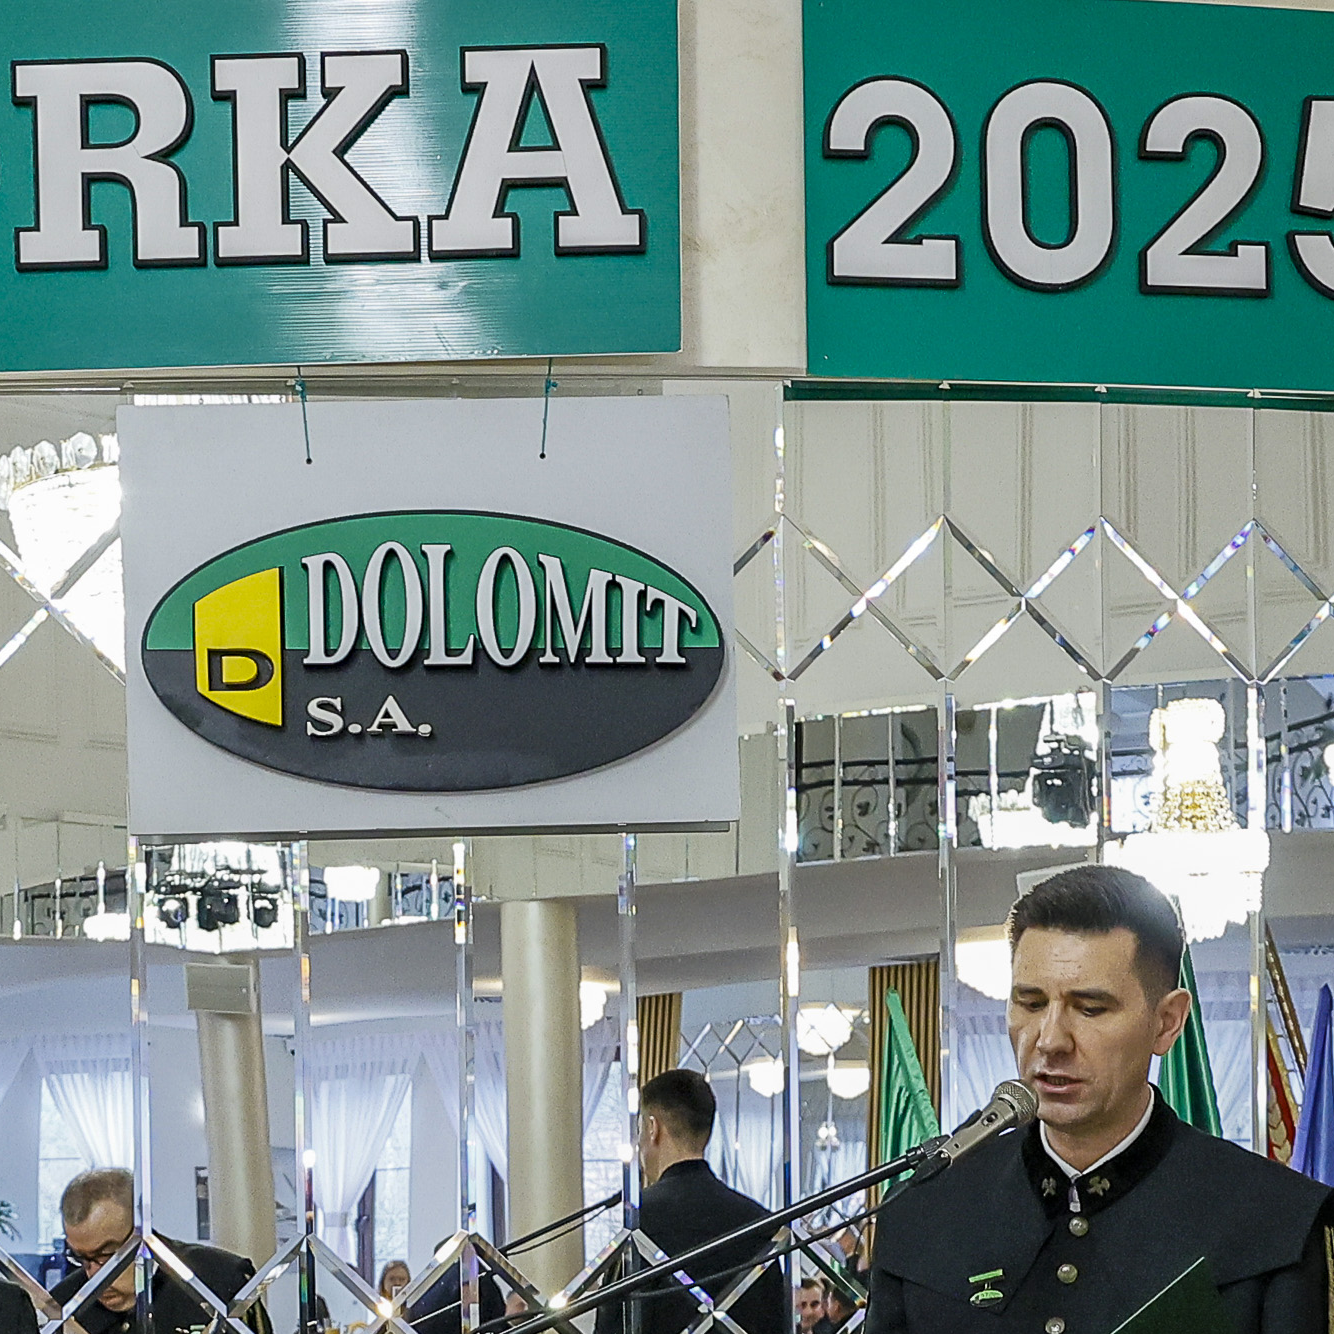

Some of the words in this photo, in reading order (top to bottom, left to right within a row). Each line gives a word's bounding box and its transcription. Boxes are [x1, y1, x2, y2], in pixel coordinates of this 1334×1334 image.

[301, 540, 698, 669] DOLOMIT
[207, 648, 275, 692] D
[305, 695, 434, 738] S.A.
